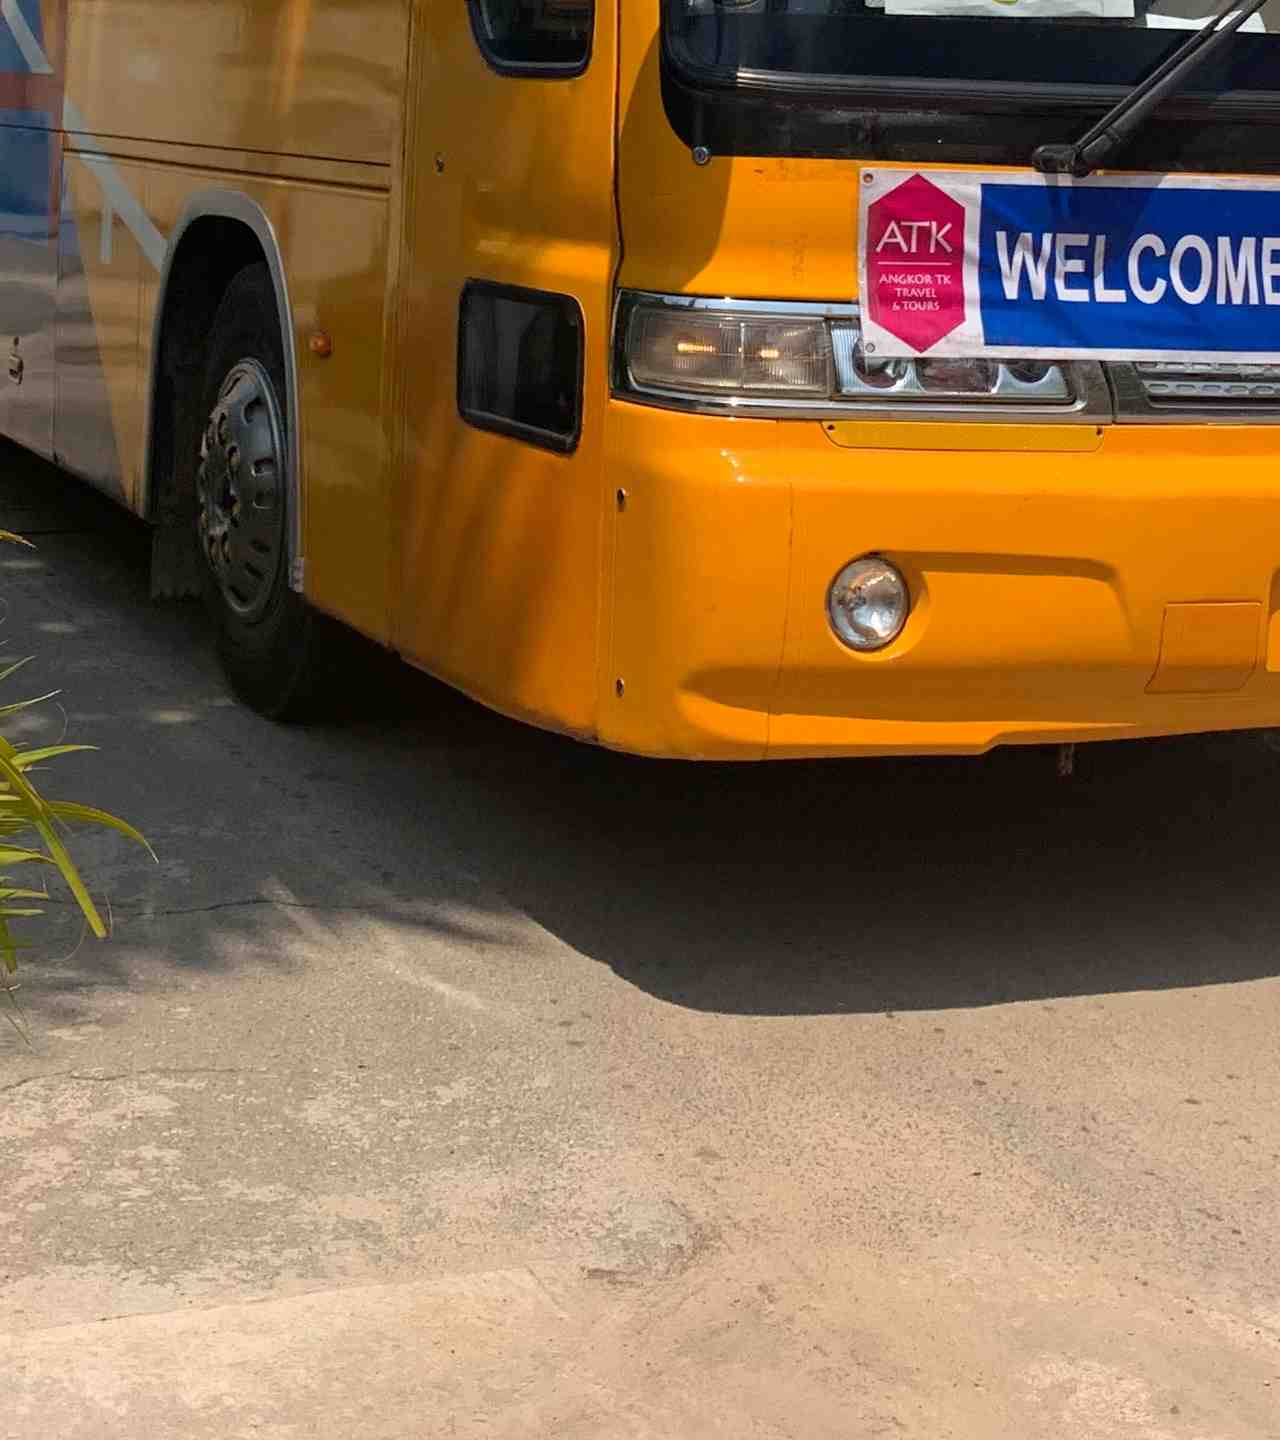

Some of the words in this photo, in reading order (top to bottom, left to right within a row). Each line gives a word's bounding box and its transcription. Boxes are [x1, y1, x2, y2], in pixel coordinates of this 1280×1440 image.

[875, 220, 953, 254] ATK
[879, 274, 932, 285] ANGKOR
[934, 274, 952, 285] TK
[894, 287, 937, 298] TRAVEL
[903, 301, 940, 311] TOURS
